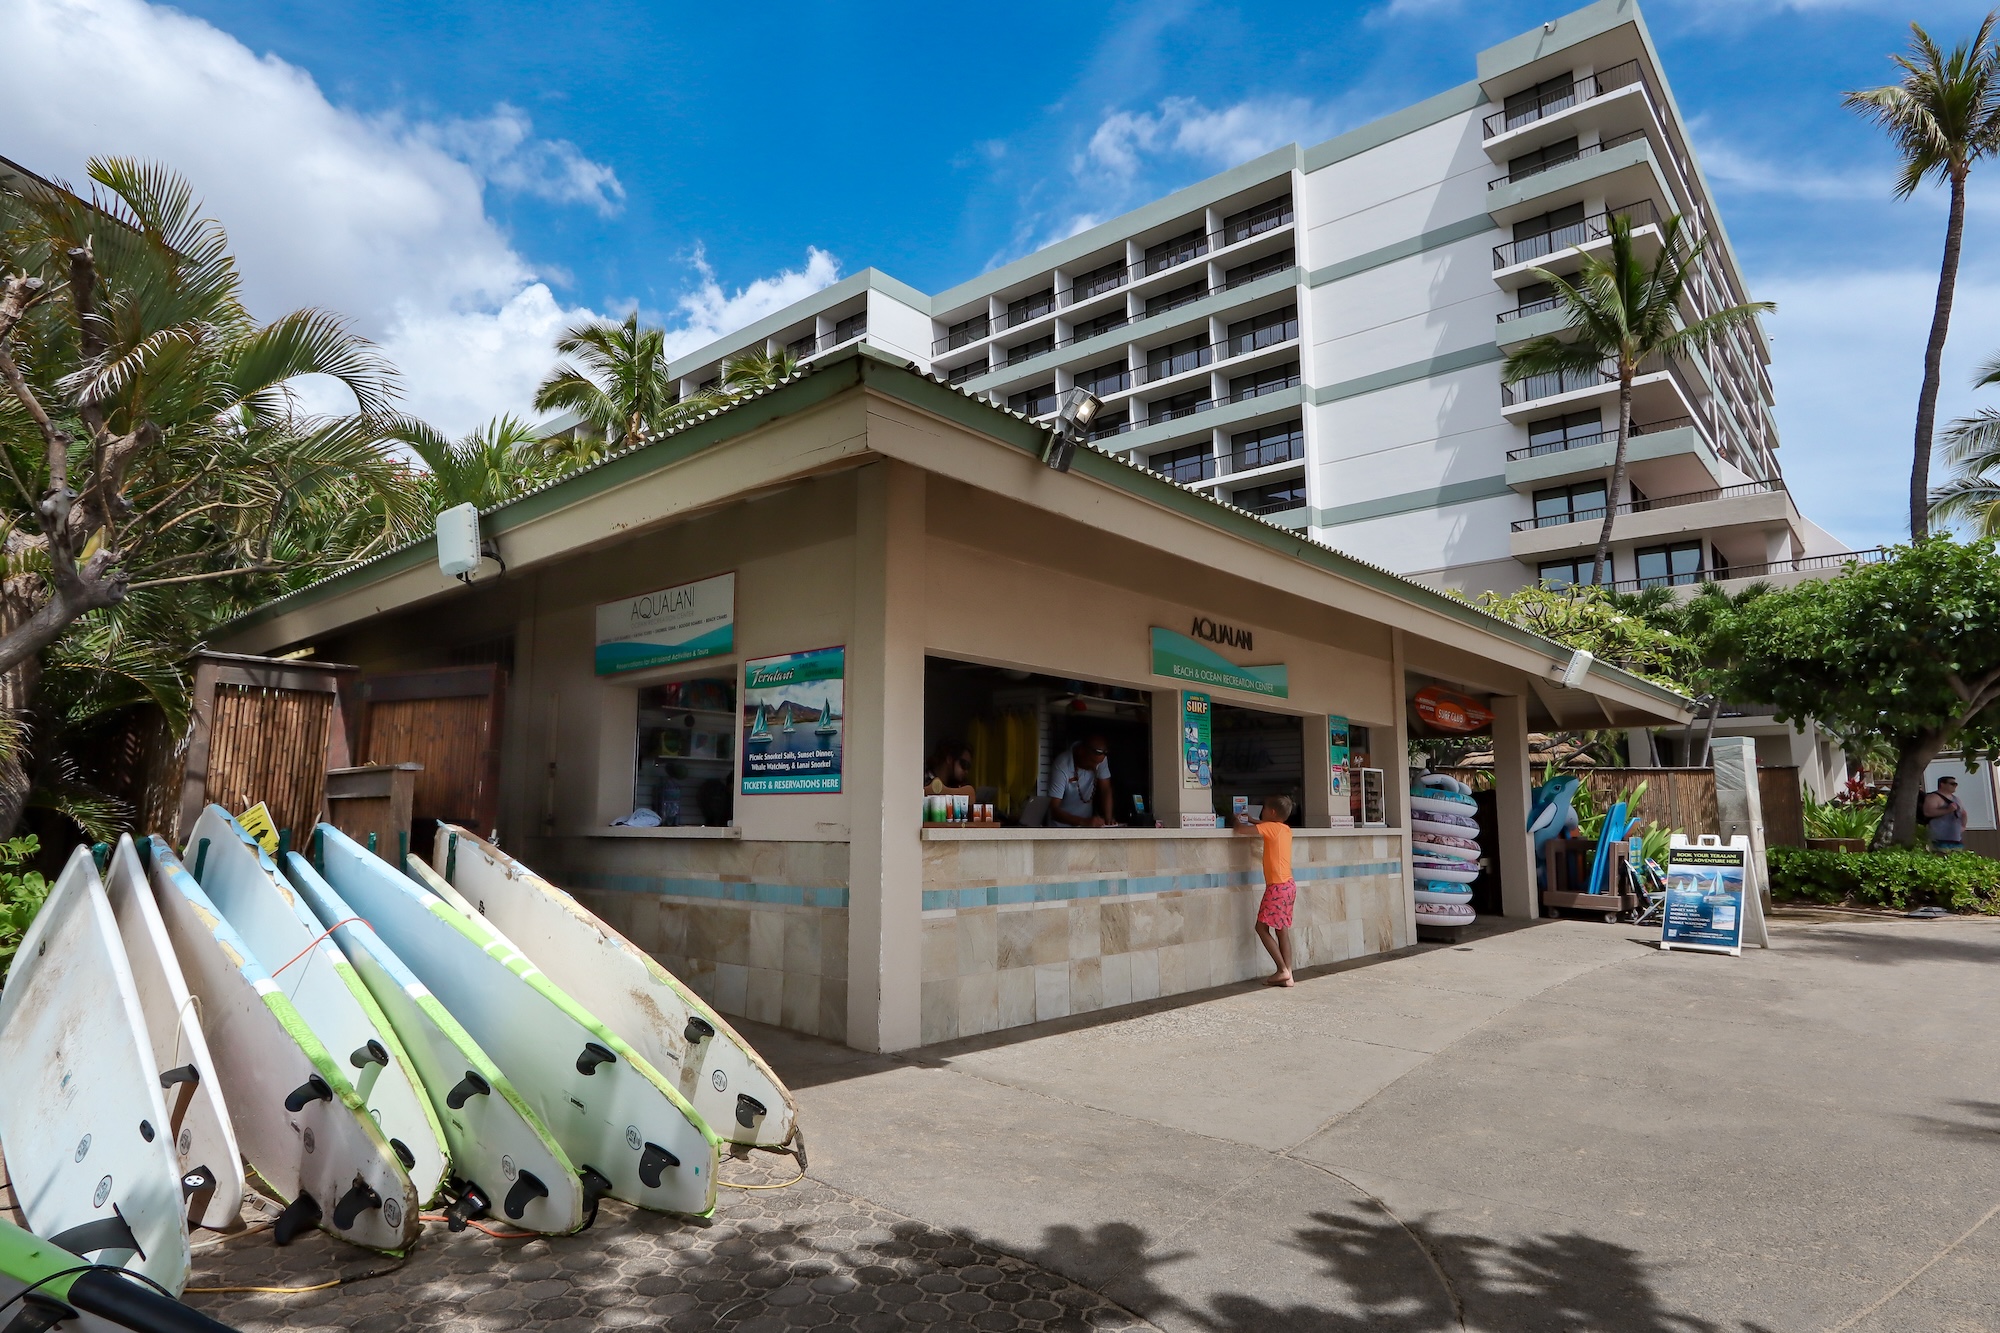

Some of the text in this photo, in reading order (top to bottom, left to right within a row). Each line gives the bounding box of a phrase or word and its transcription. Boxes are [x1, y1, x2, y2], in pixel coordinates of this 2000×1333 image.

[631, 586, 695, 621] AQUALANI
[649, 614, 677, 626] RECREATION
[677, 611, 695, 620] CENTER
[1191, 616, 1253, 651] AQUALANI
[616, 660, 644, 669] Reservations
[671, 650, 692, 661] Activities
[752, 666, 794, 686] Teralani
[1173, 664, 1273, 692] BEACH & OCEAN RECREATION CENTER
[1186, 700, 1208, 714] SURF
[1438, 708, 1450, 720] SURF
[1450, 712, 1463, 723] CLUB
[749, 753, 763, 761] Picnic
[784, 752, 796, 760] Sails,
[815, 750, 834, 758] Dinner,
[766, 763, 790, 771] Watching,
[811, 760, 831, 768] Snorkel
[744, 779, 838, 790] TICKETS & RESERVATIONS HERE
